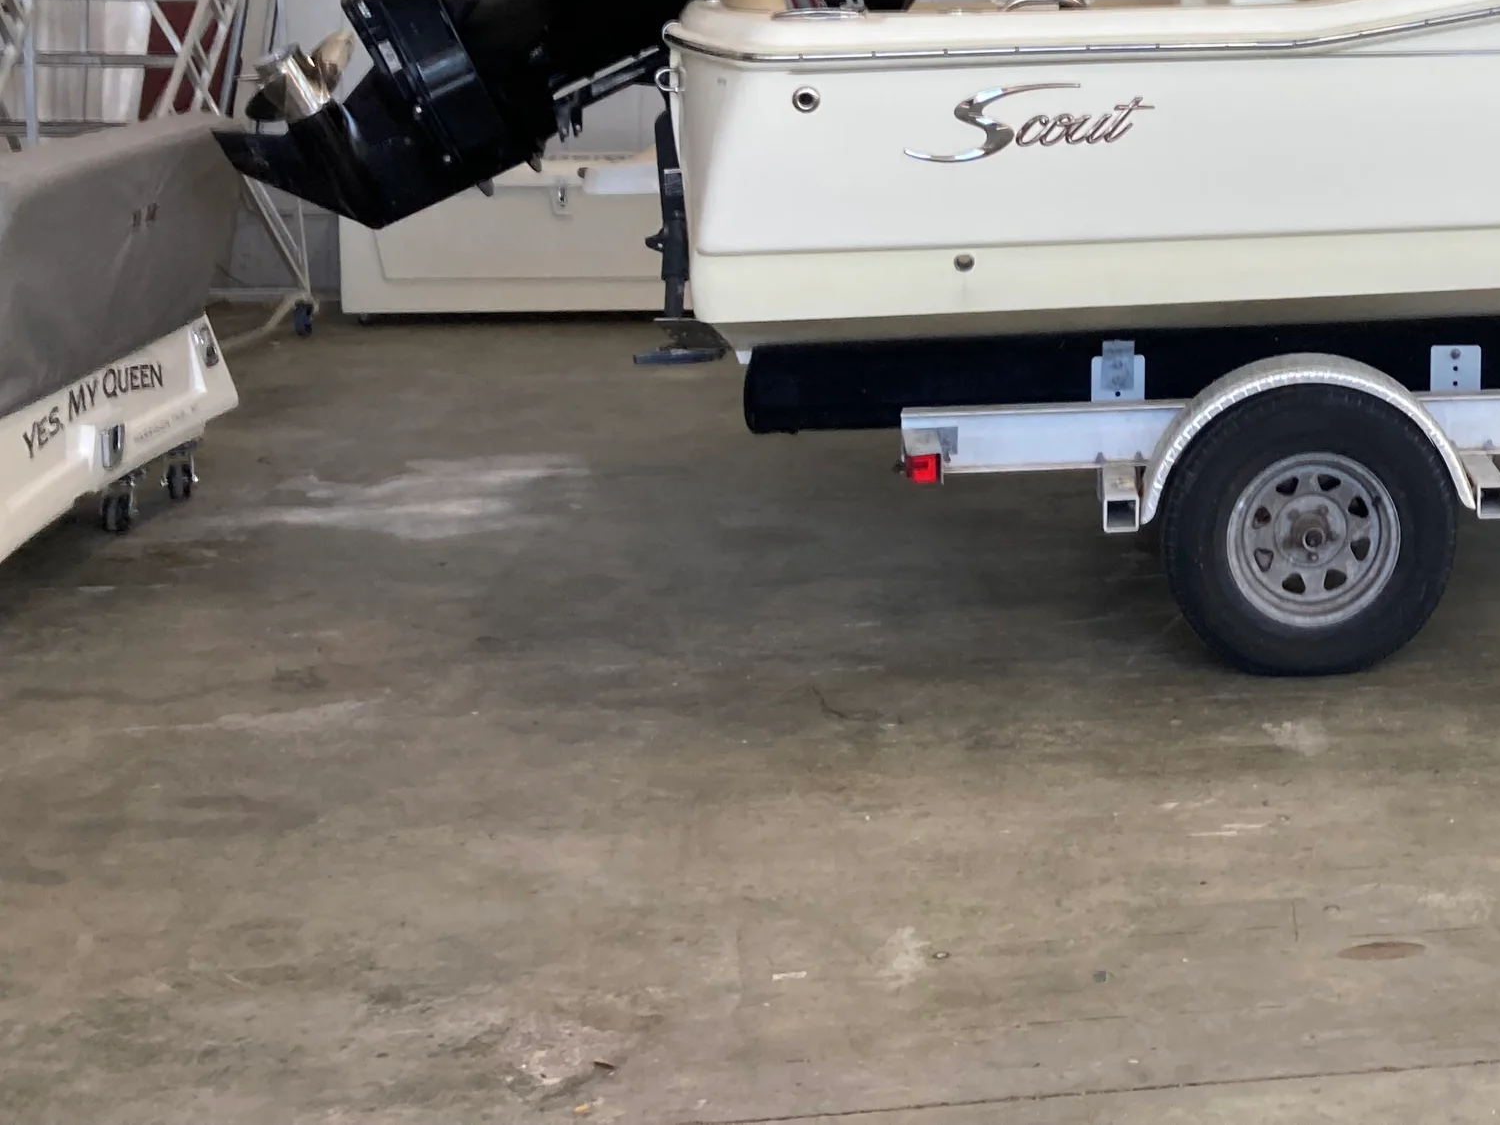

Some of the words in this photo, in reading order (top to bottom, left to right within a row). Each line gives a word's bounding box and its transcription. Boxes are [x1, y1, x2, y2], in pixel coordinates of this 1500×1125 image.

[903, 82, 1155, 163] Scout
[68, 378, 99, 423] MY
[102, 363, 164, 399] QUEEN
